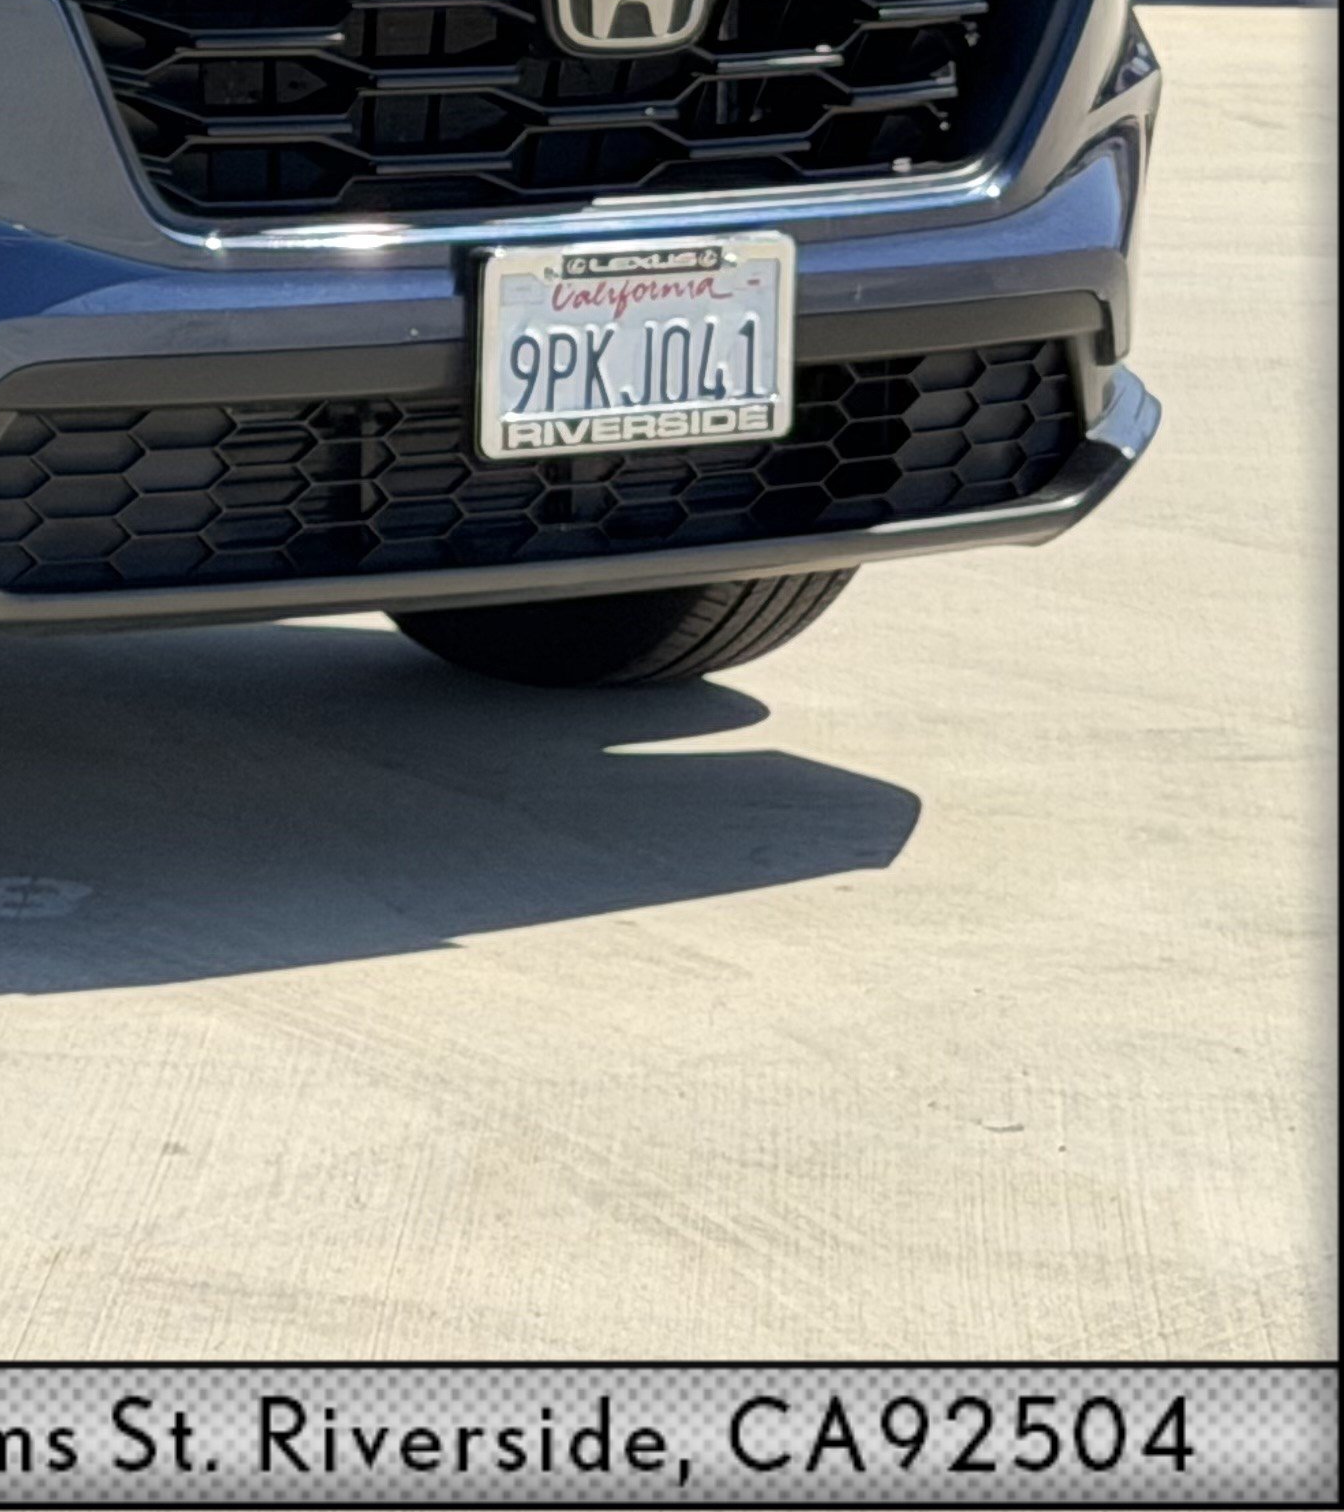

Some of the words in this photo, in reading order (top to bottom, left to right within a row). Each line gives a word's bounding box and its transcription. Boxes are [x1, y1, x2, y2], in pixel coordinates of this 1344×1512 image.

[588, 251, 697, 273] LEXUS
[551, 276, 734, 320] California
[509, 318, 764, 413] 9PKJ041
[507, 405, 770, 449] RIVERSIDE
